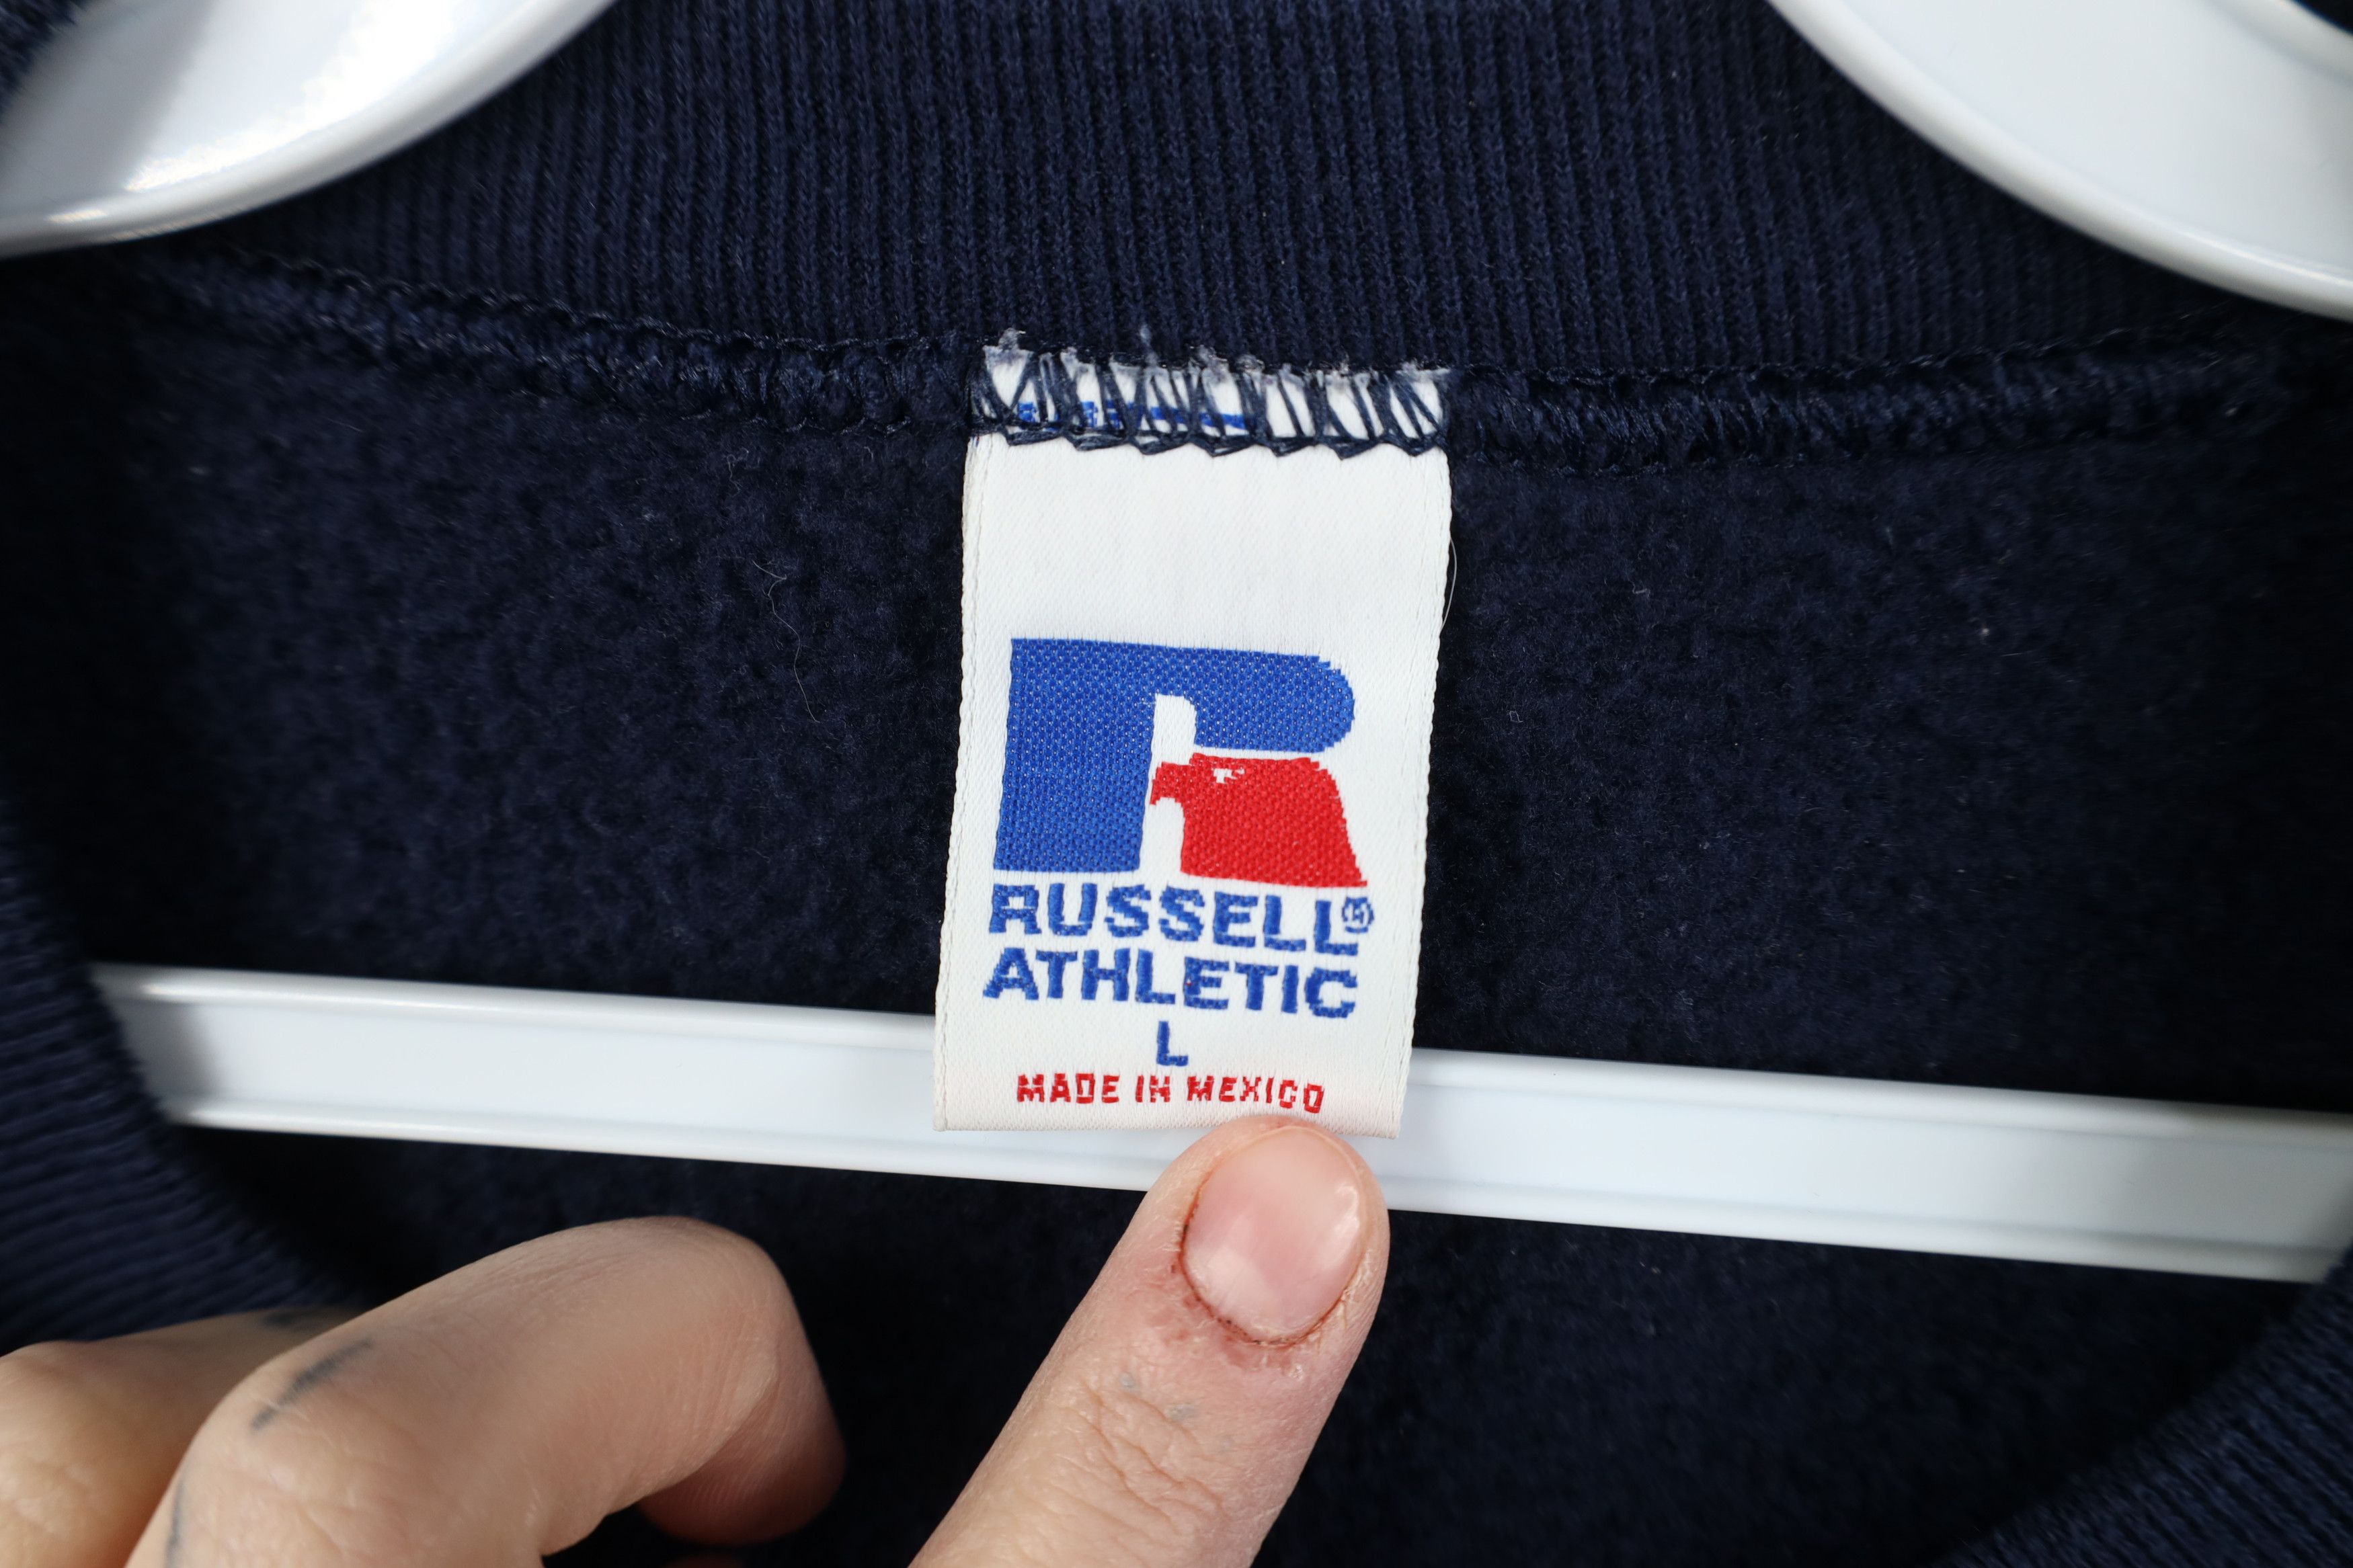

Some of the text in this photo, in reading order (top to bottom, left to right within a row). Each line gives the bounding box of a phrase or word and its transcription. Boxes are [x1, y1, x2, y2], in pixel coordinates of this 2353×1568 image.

[983, 947, 1358, 1019] ATHLETIC
[1156, 1020, 1189, 1067] L
[1016, 1073, 1324, 1114] MADE IN MEXICO
